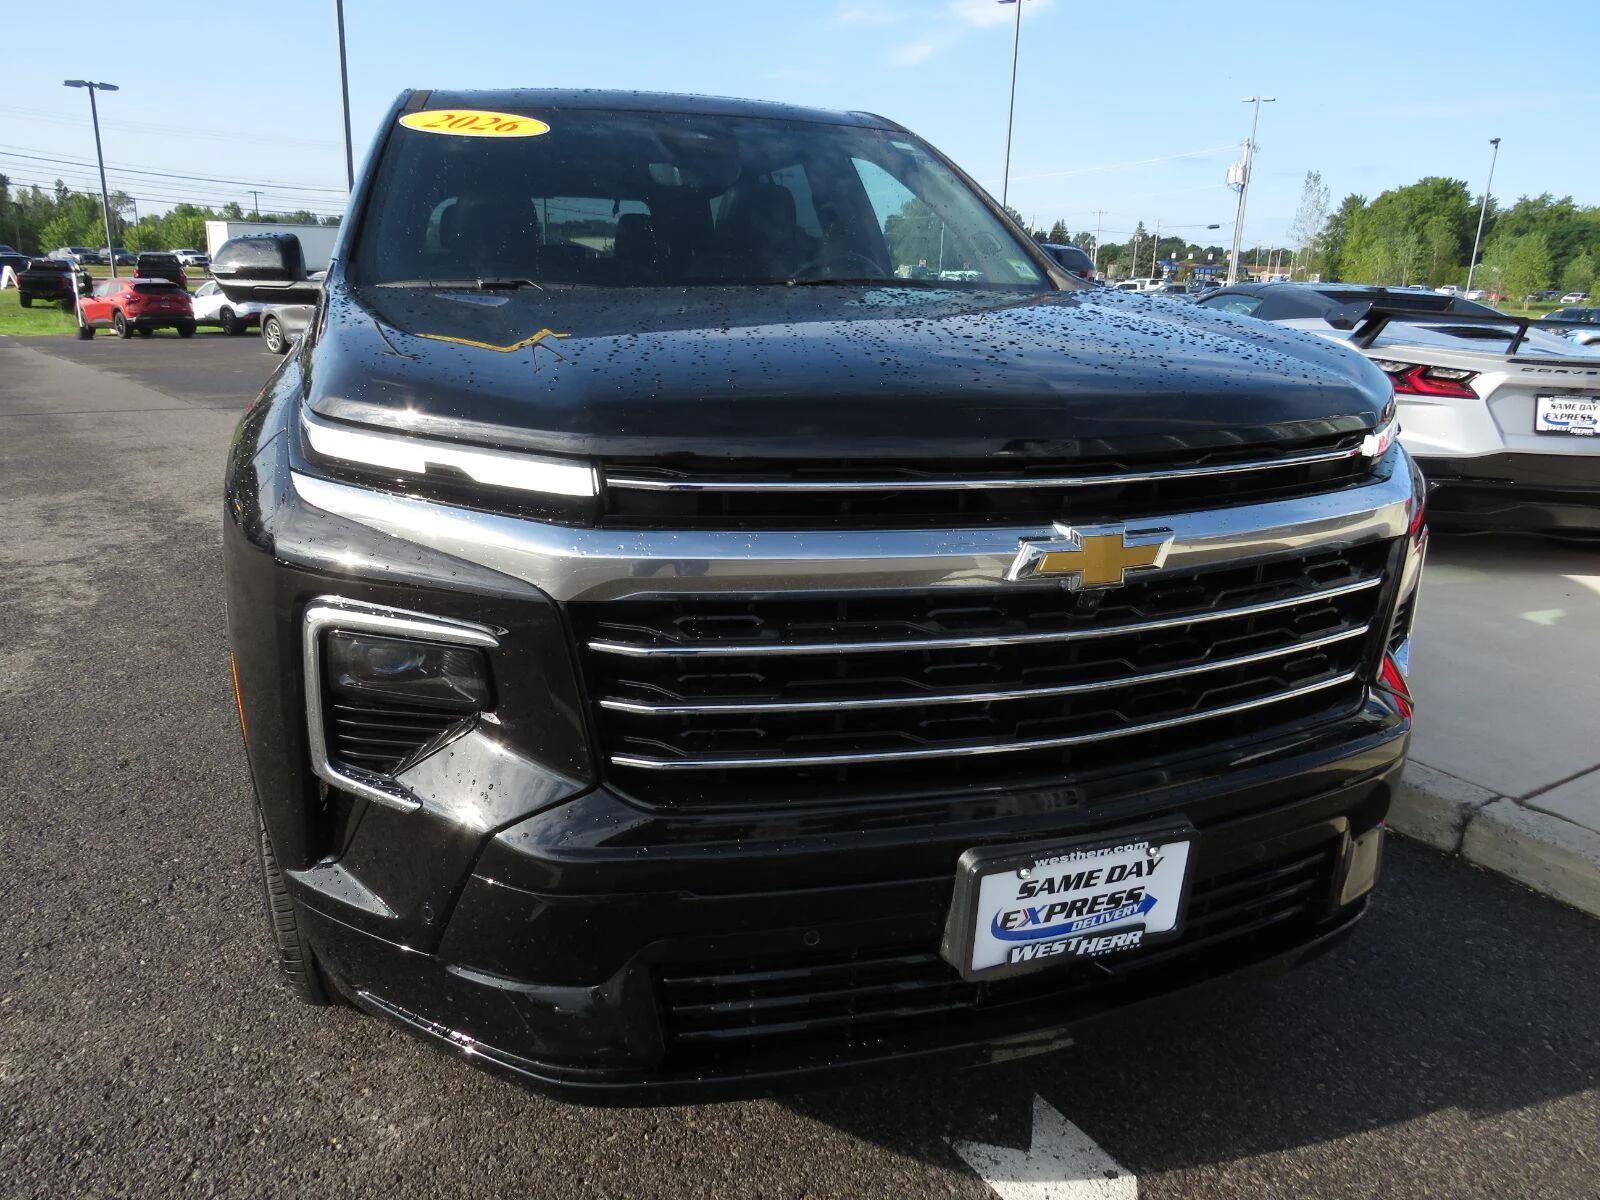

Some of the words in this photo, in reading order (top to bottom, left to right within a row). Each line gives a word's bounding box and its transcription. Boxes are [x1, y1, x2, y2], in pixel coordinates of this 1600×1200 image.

[421, 114, 524, 132] 2026
[1545, 412, 1594, 421] EXPRESS
[1550, 403, 1577, 411] SAME
[1578, 403, 1599, 411] DAY
[1034, 841, 1149, 868] westherr.com
[1015, 868, 1104, 900] SAME
[1104, 856, 1165, 885] DAY
[999, 886, 1146, 931] EXPRESS
[1071, 901, 1142, 932] DELIVERY
